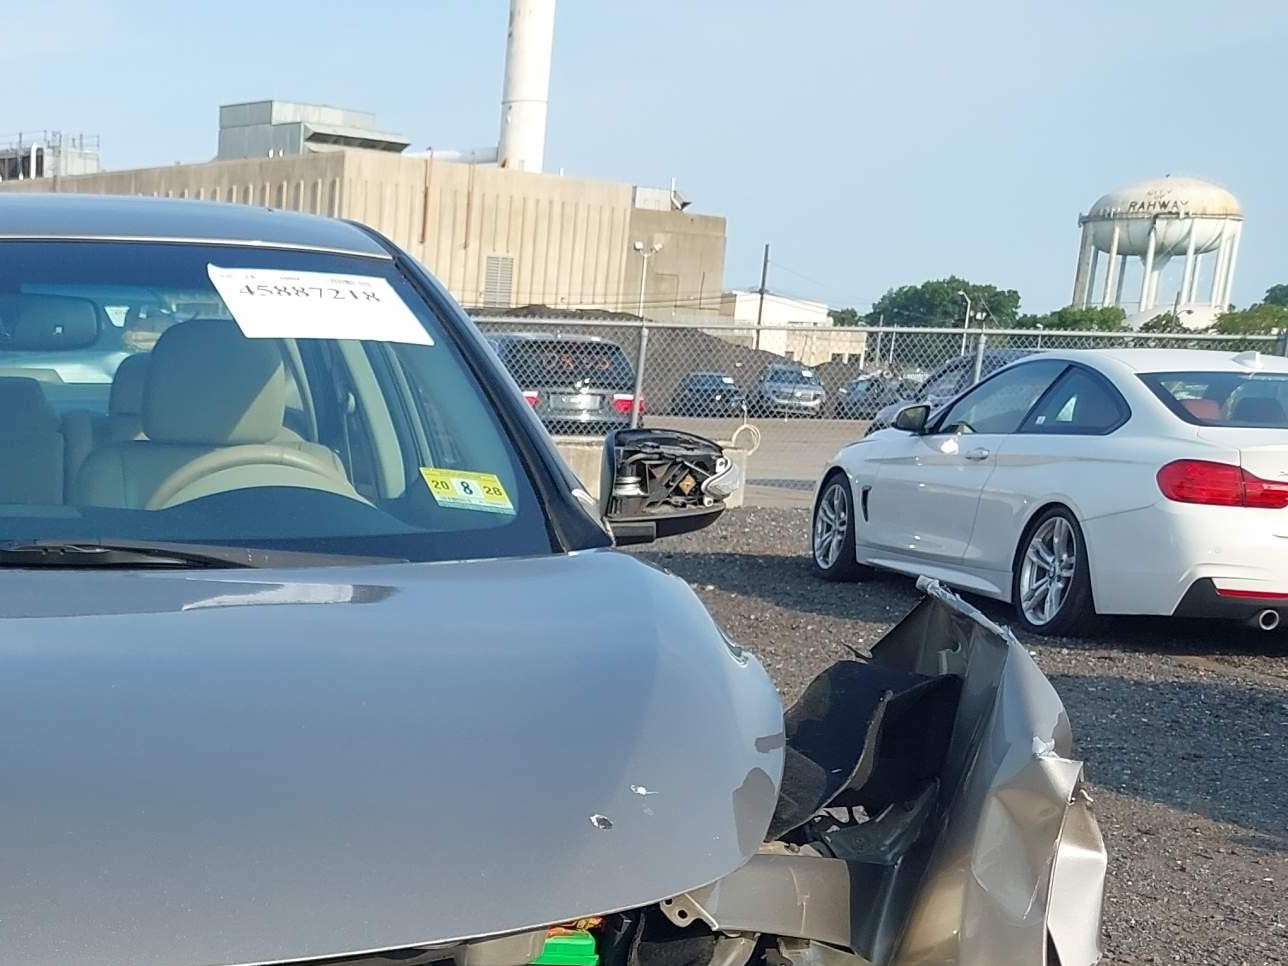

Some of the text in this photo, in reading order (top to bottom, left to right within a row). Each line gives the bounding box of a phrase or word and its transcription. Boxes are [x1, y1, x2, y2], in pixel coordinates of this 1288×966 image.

[1128, 200, 1189, 211] RAHWAY
[431, 480, 450, 490] 20
[460, 481, 473, 495] 8
